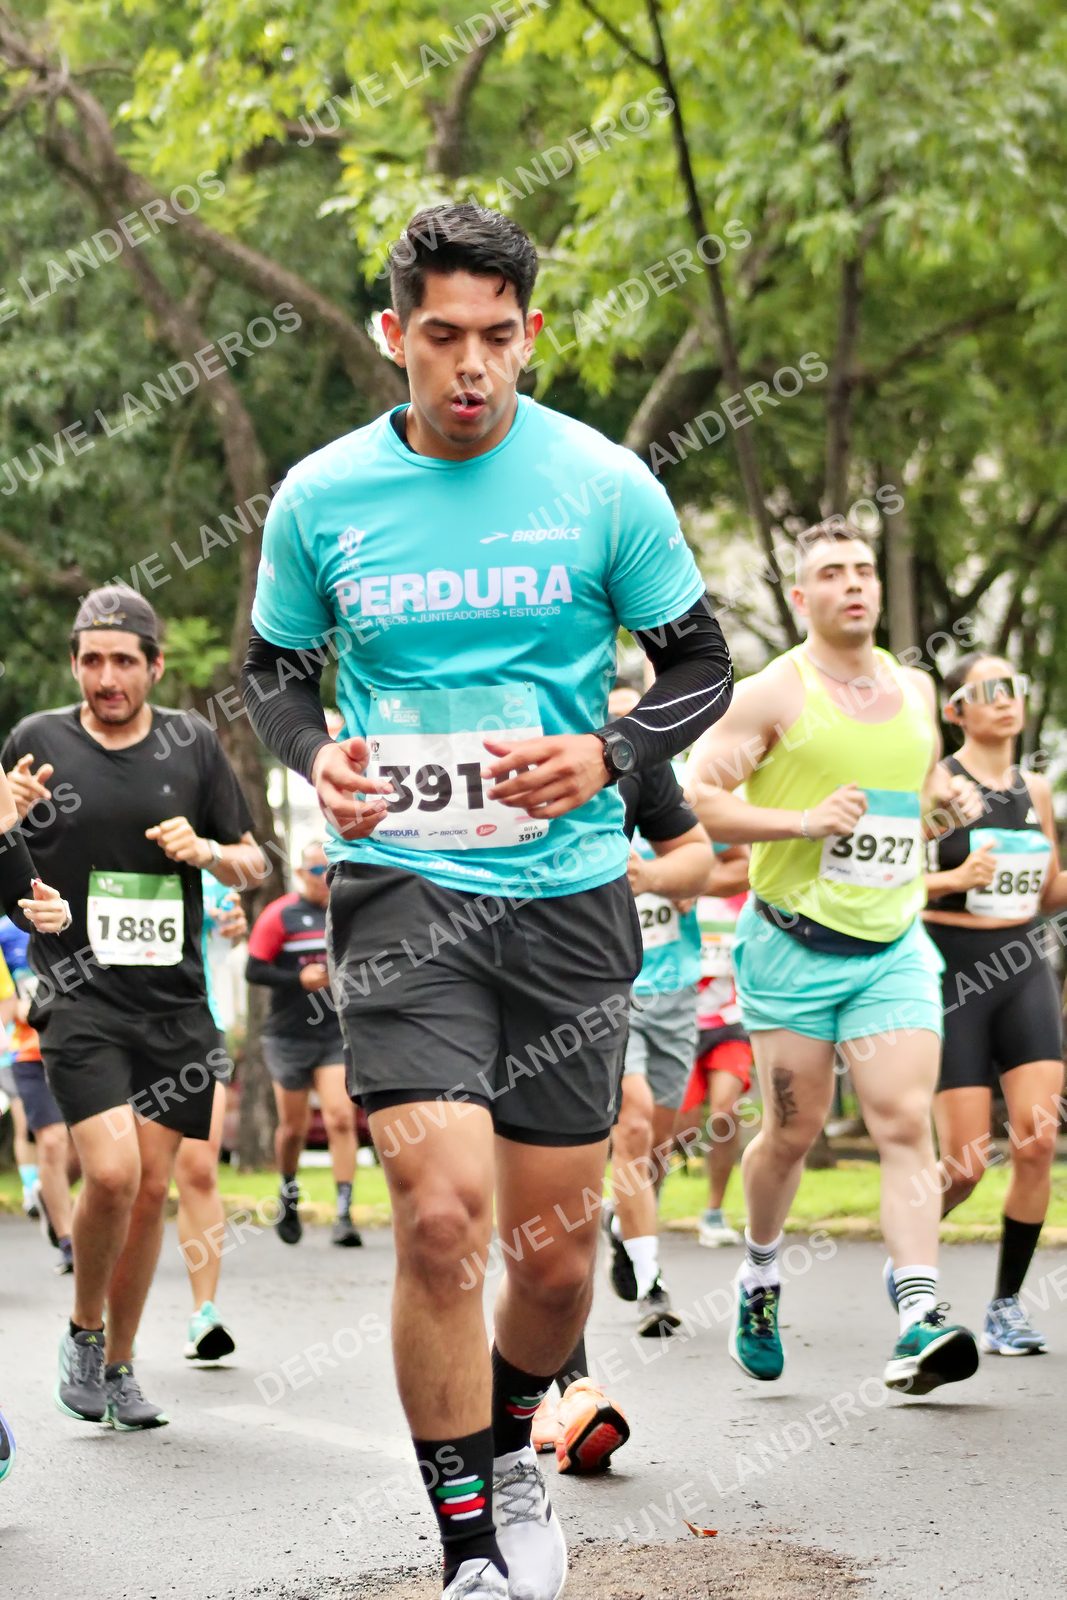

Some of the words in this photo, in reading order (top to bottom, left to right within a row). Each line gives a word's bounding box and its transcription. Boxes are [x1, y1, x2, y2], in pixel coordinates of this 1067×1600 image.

[511, 527, 582, 543] BROOKS
[334, 564, 573, 616] PERDURA
[416, 609, 500, 623] JUNTEADORES
[509, 606, 561, 618] ESTUCOS
[379, 762, 528, 813] 391
[379, 829, 420, 837] PERDURA
[519, 831, 543, 842] 3910
[830, 832, 914, 865] 3927
[98, 915, 176, 943] 1886
